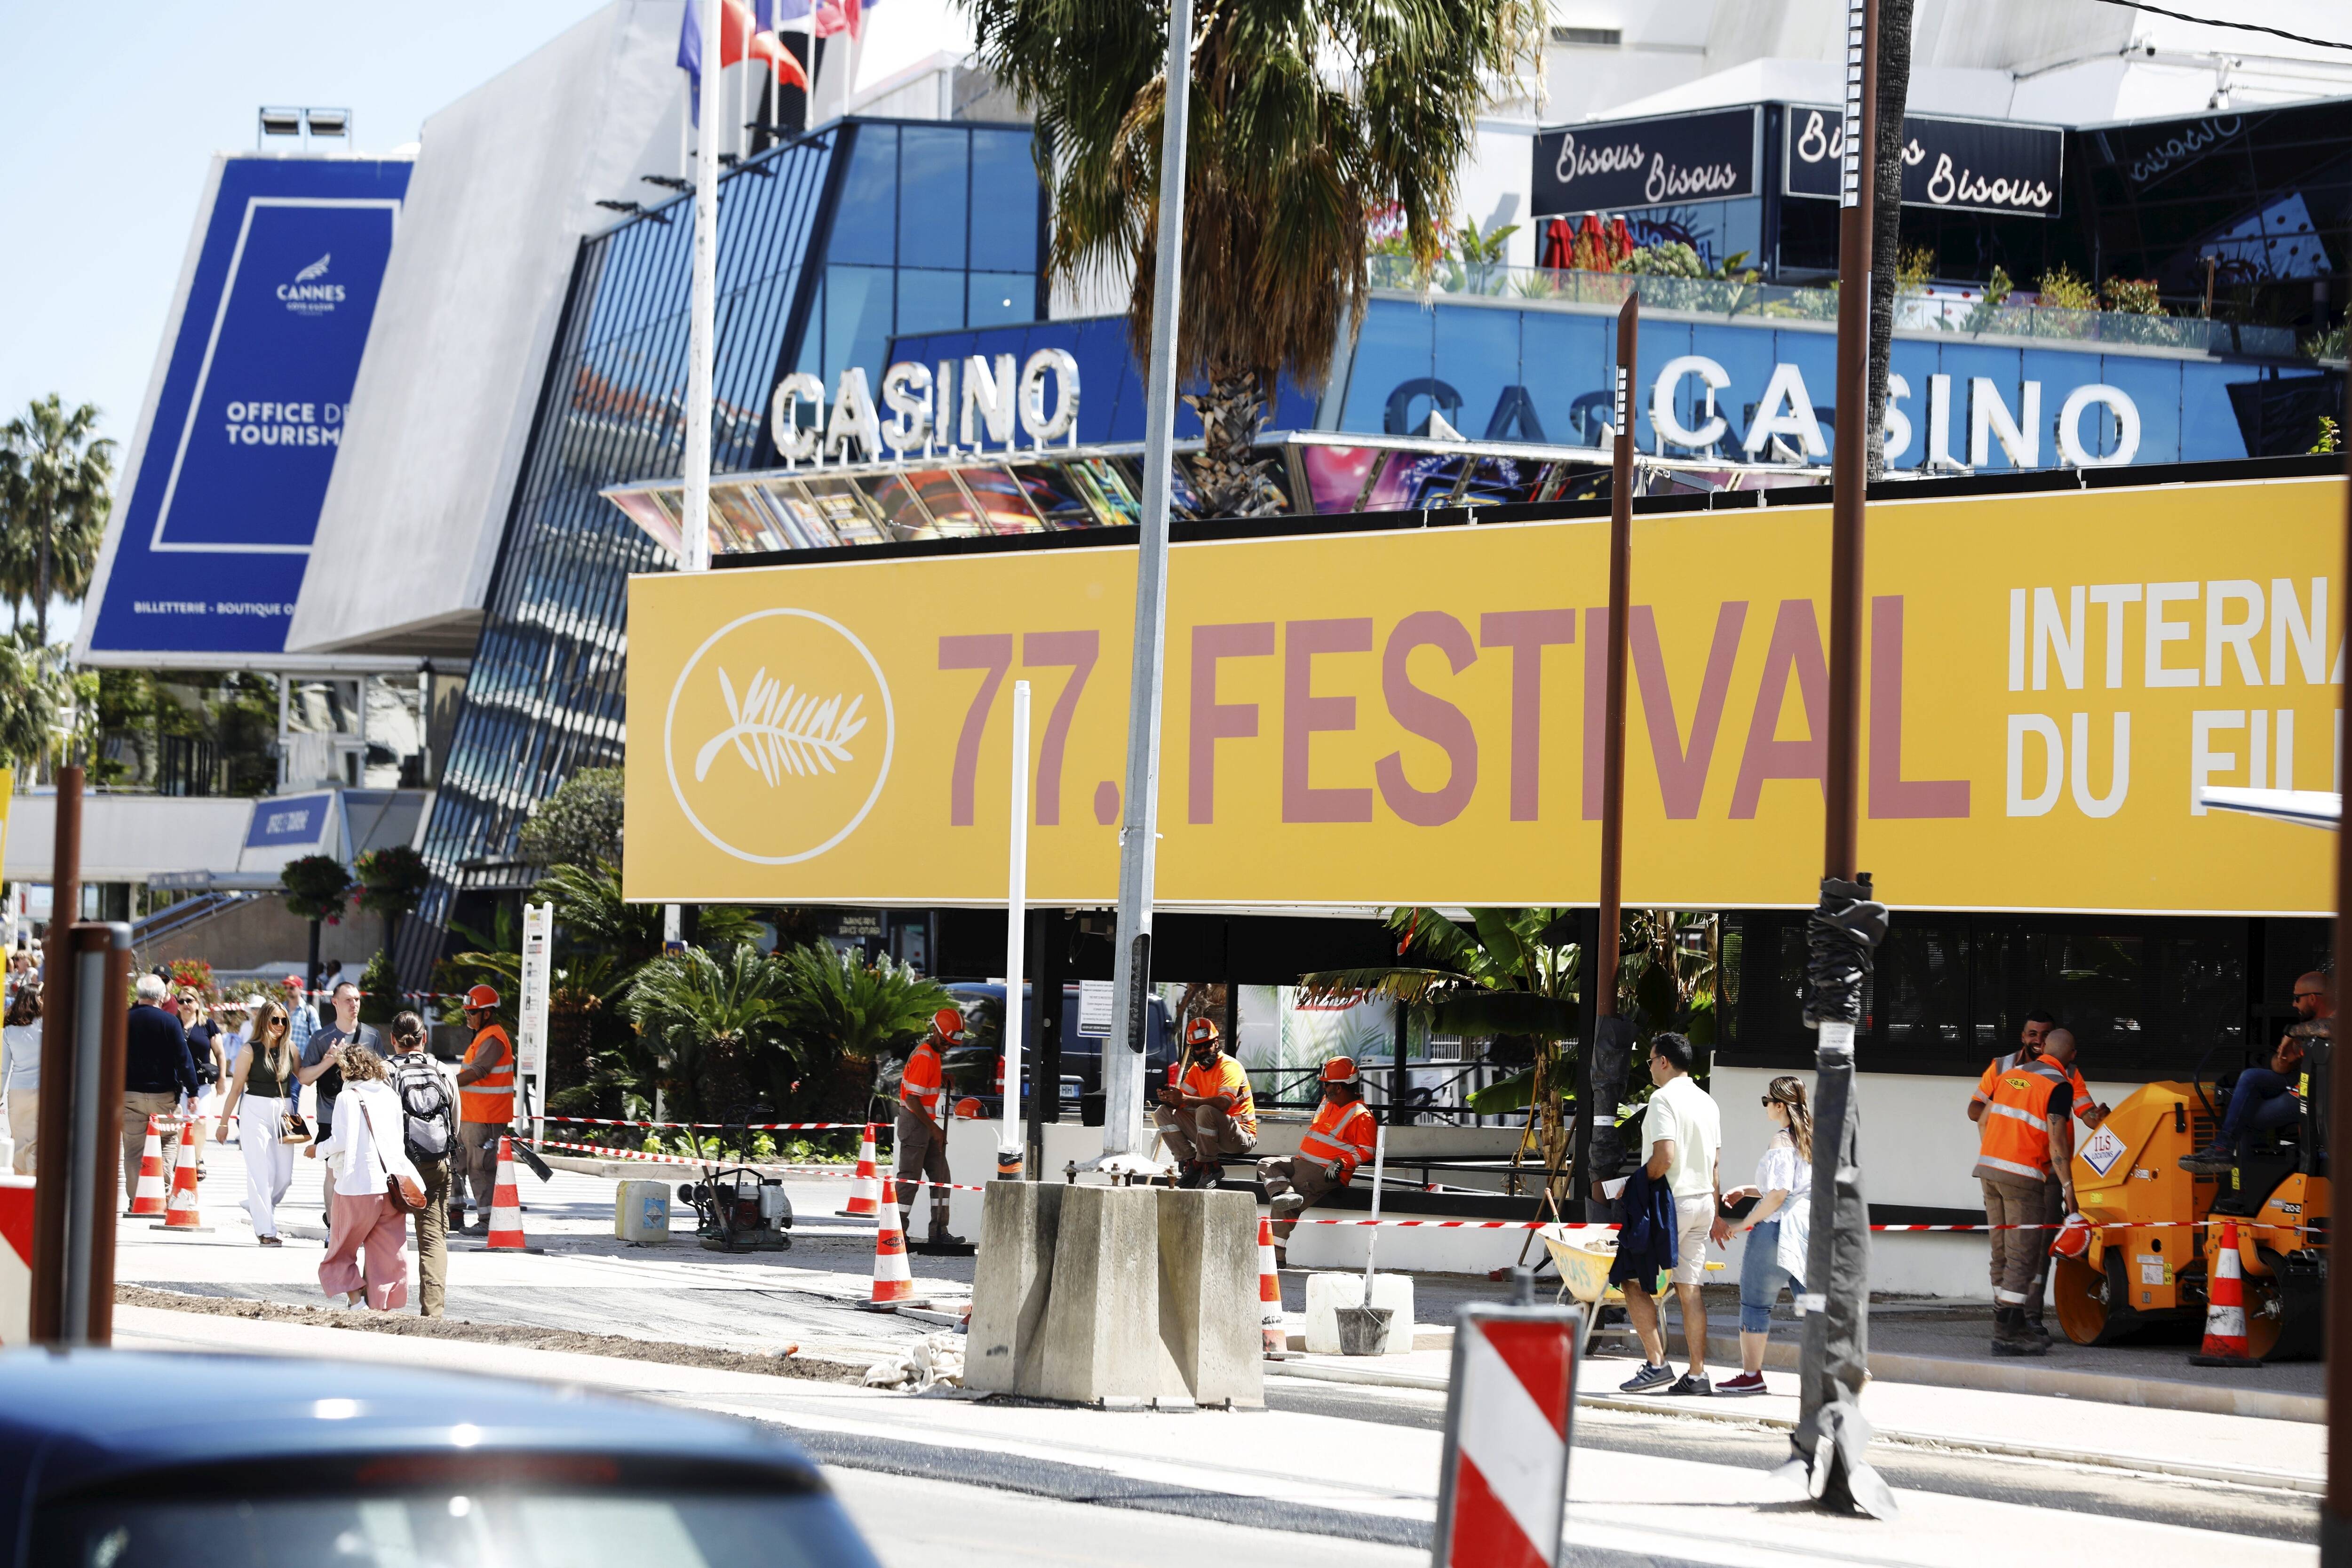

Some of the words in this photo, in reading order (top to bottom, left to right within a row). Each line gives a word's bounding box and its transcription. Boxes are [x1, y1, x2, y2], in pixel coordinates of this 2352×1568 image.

[1556, 133, 1645, 184] Bisous
[1645, 152, 1737, 203] Bisous
[1927, 152, 2052, 206] Bisous
[277, 284, 346, 302] CANNES
[226, 401, 315, 423] OFFICE
[771, 348, 1081, 460] CASINO
[134, 600, 206, 614] BILLETTERIE
[216, 602, 281, 618] BOUTIQUE
[283, 603, 295, 615] O
[1187, 595, 1971, 826] FESTIVAL
[2006, 711, 2130, 818] DU
[2190, 708, 2344, 816] FIL
